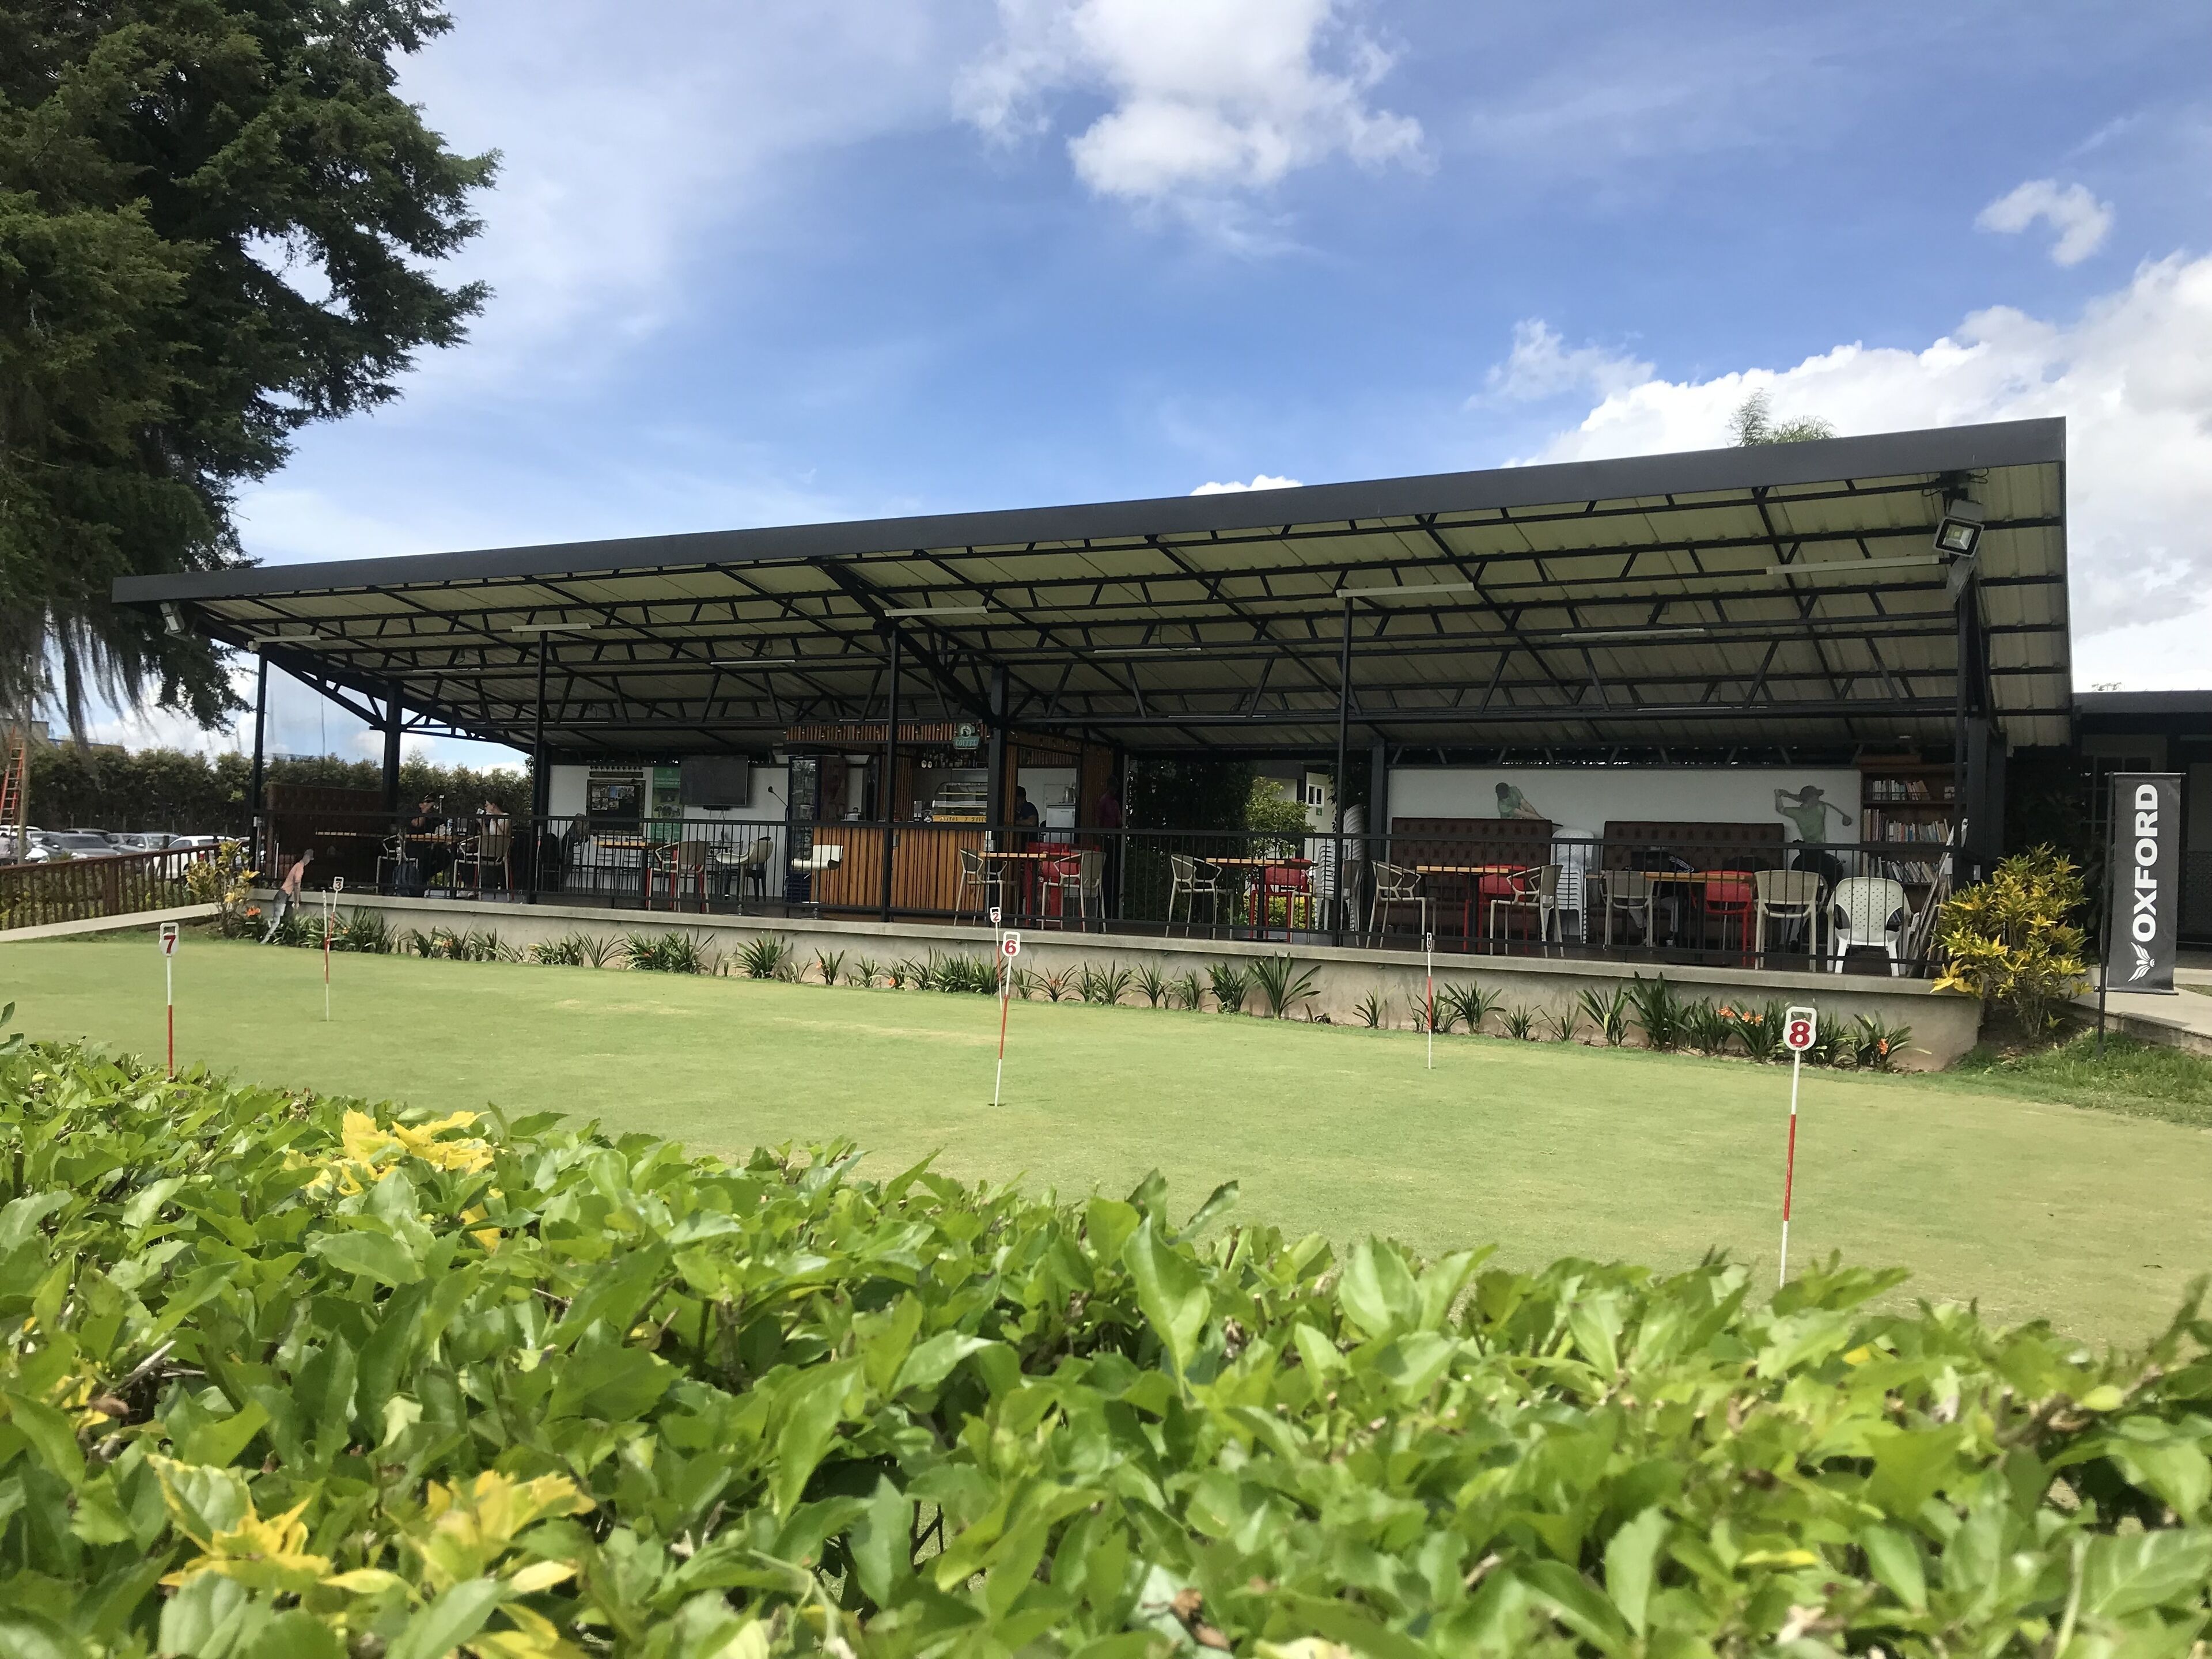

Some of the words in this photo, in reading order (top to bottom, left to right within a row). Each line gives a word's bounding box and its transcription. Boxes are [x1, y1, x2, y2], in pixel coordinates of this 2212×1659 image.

[2133, 784, 2158, 942] OXFORD
[335, 881, 342, 889] 3
[993, 912, 999, 921] 2
[164, 935, 176, 954] 7
[1005, 940, 1017, 955] 6
[1789, 1021, 1810, 1048] 8
